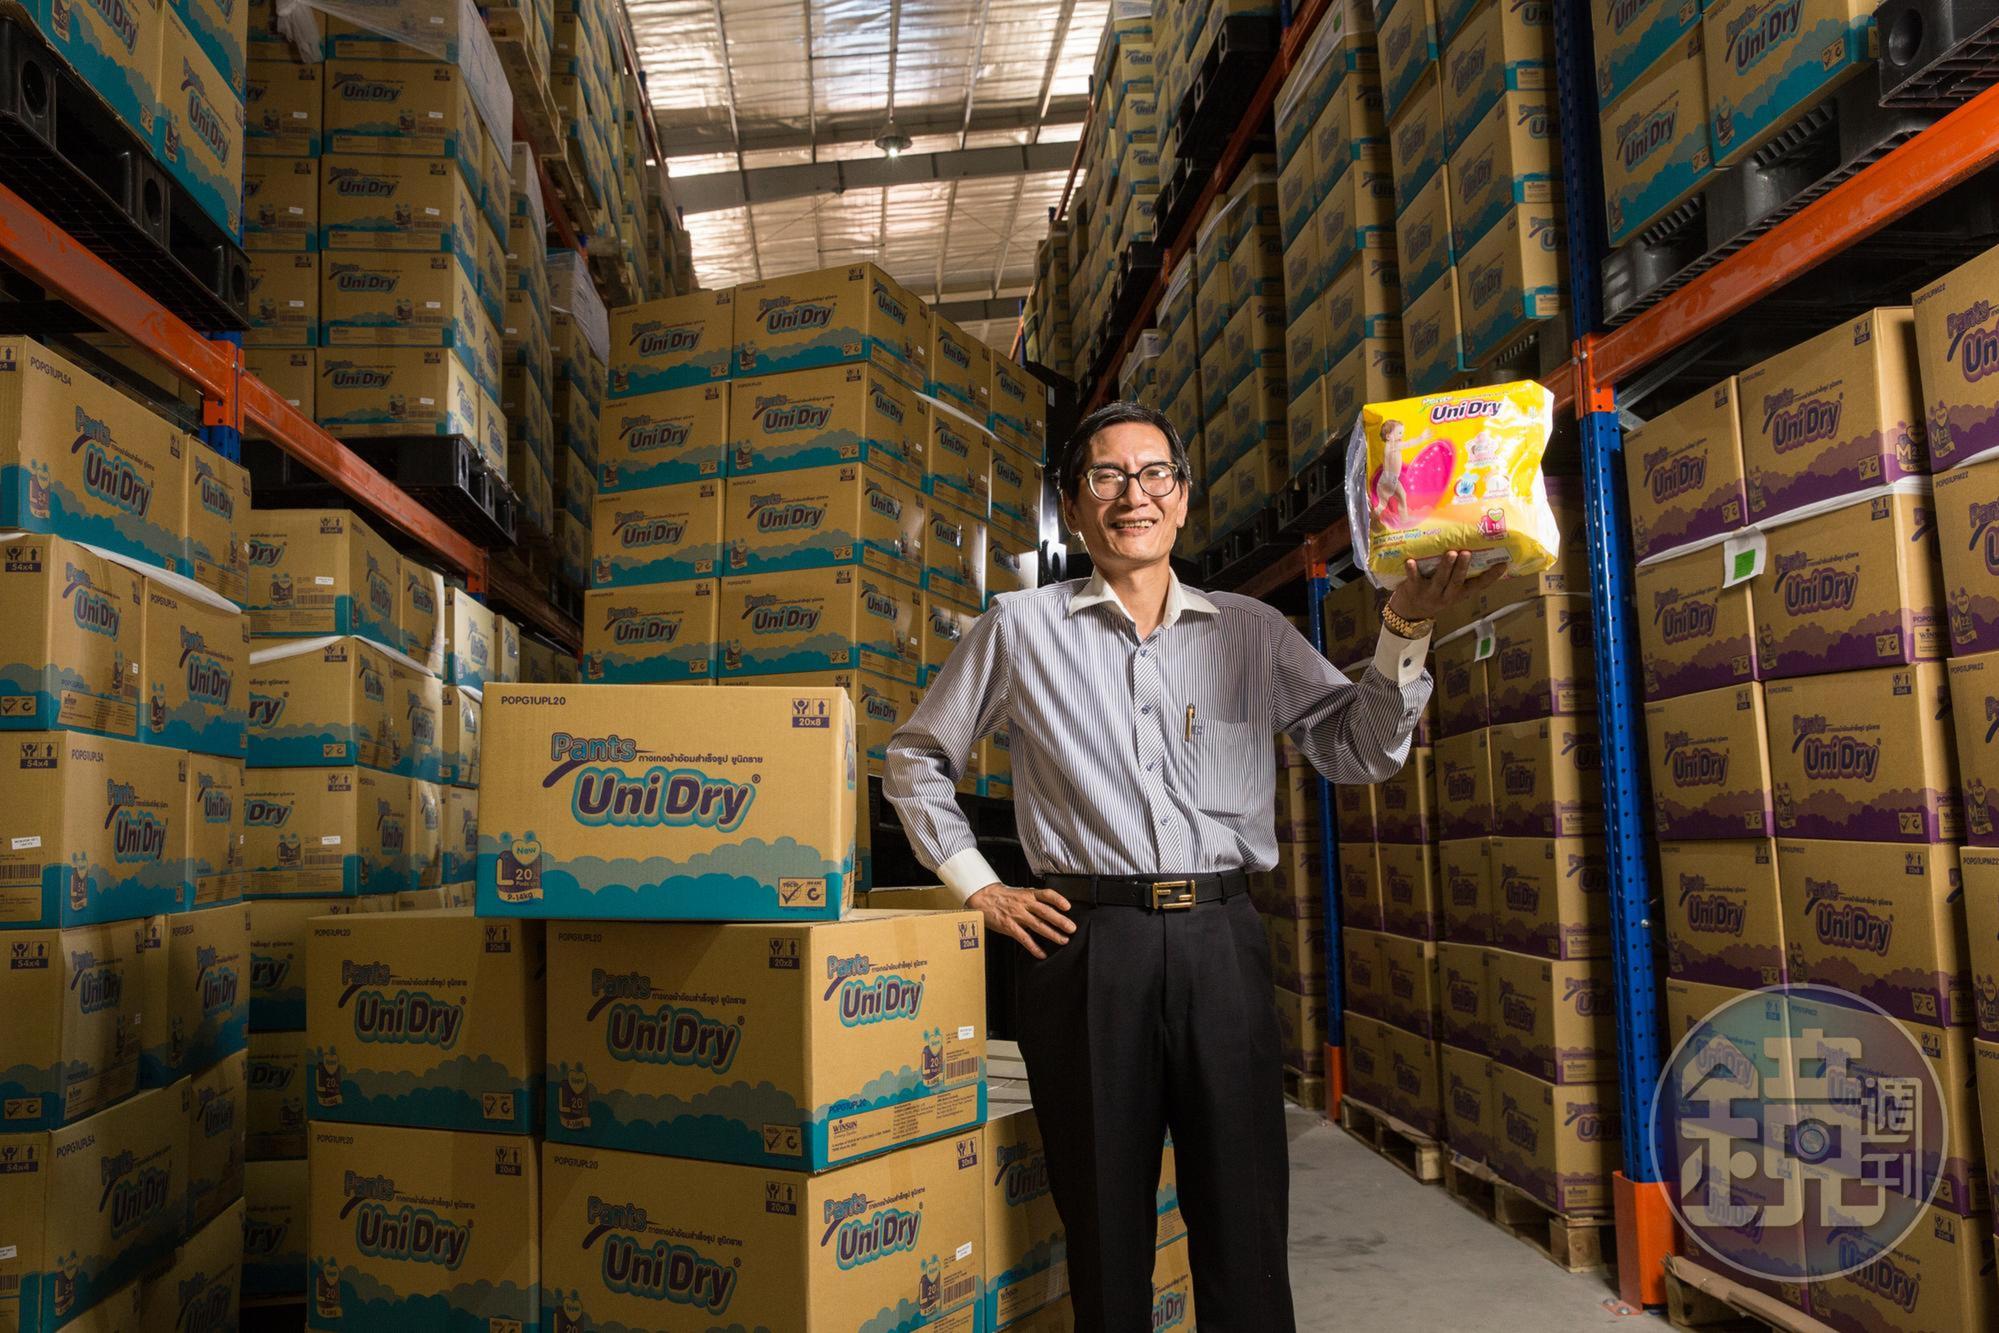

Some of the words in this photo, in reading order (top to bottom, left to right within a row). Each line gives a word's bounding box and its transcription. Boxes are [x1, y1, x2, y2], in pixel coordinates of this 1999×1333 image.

[501, 696, 566, 706] POPG1UPL20
[800, 718, 821, 726] 20x8
[551, 732, 637, 762] Pants
[497, 859, 514, 885] L
[516, 869, 532, 880] 20
